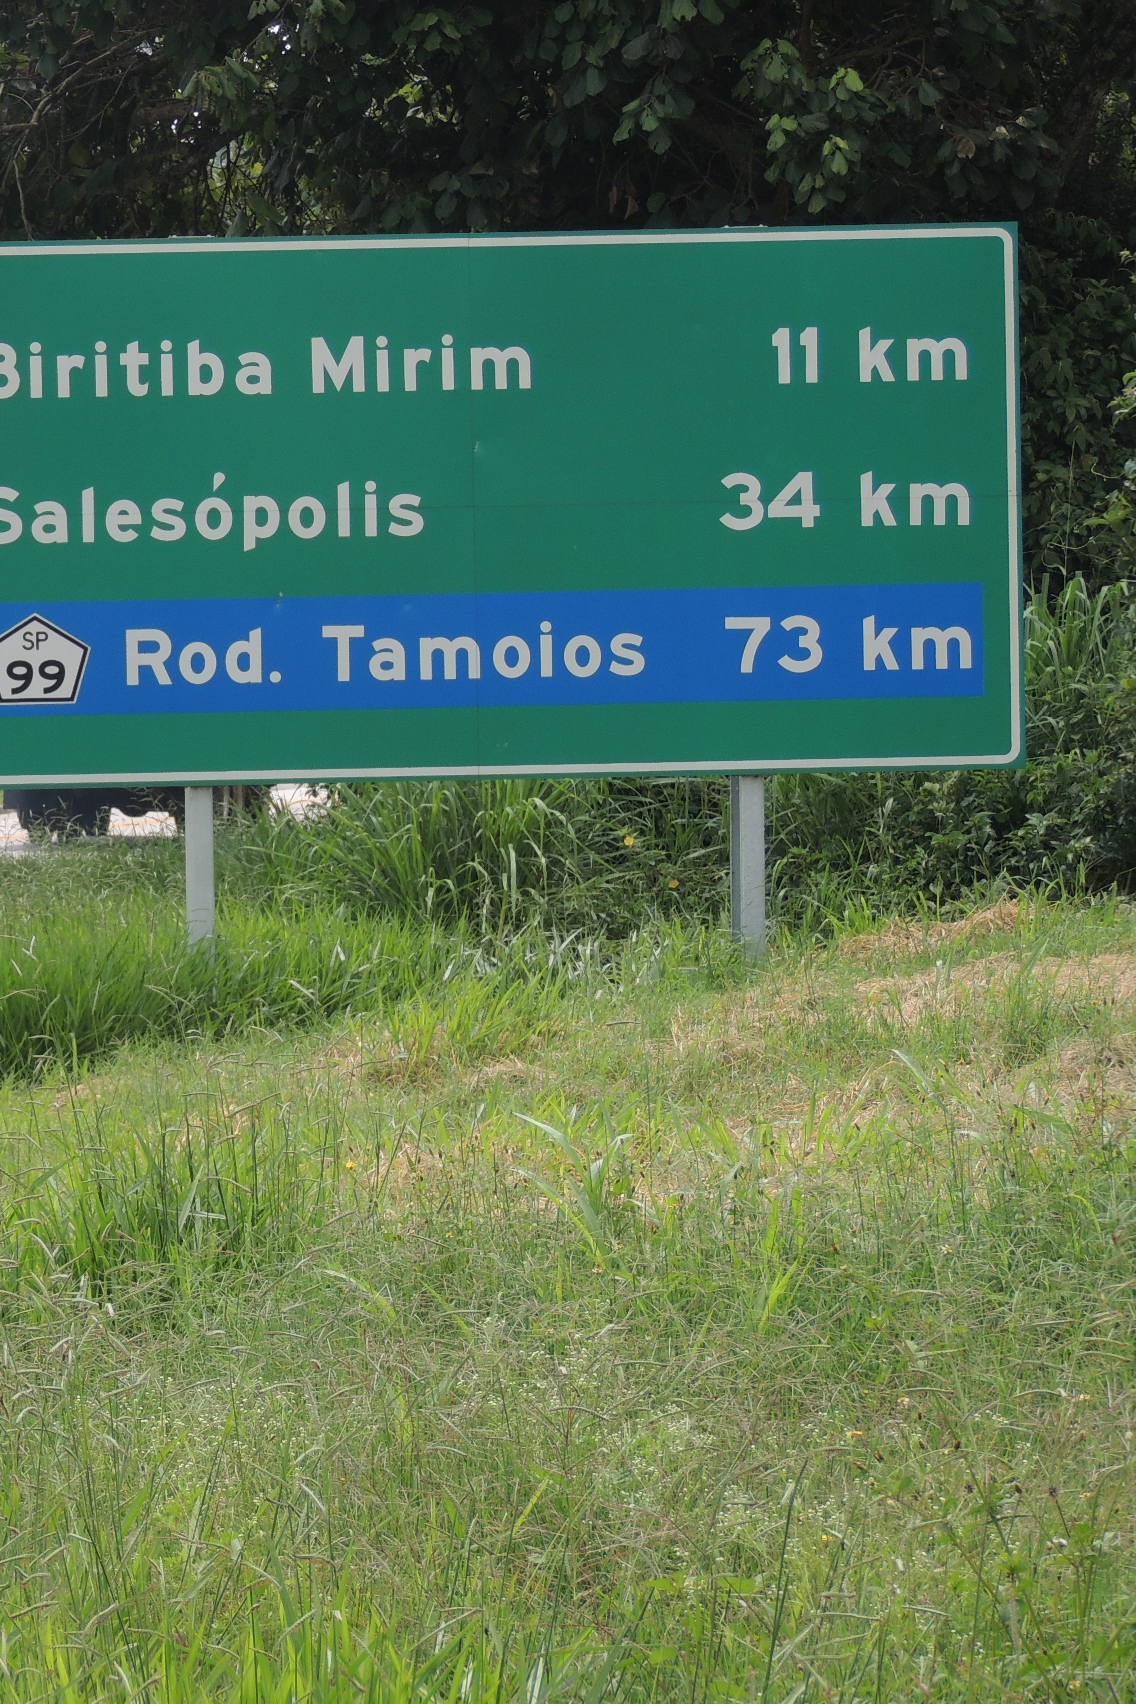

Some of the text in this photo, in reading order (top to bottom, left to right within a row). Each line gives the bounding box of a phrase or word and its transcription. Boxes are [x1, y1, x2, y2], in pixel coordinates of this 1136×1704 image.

[311, 334, 532, 394] Mirim
[771, 326, 818, 384] 11
[859, 326, 968, 383] km
[719, 471, 821, 531] 34
[860, 471, 970, 527] km
[22, 631, 49, 651] SP
[125, 614, 972, 686] Rod. Tamoios 73 km
[6, 659, 66, 695] 99
